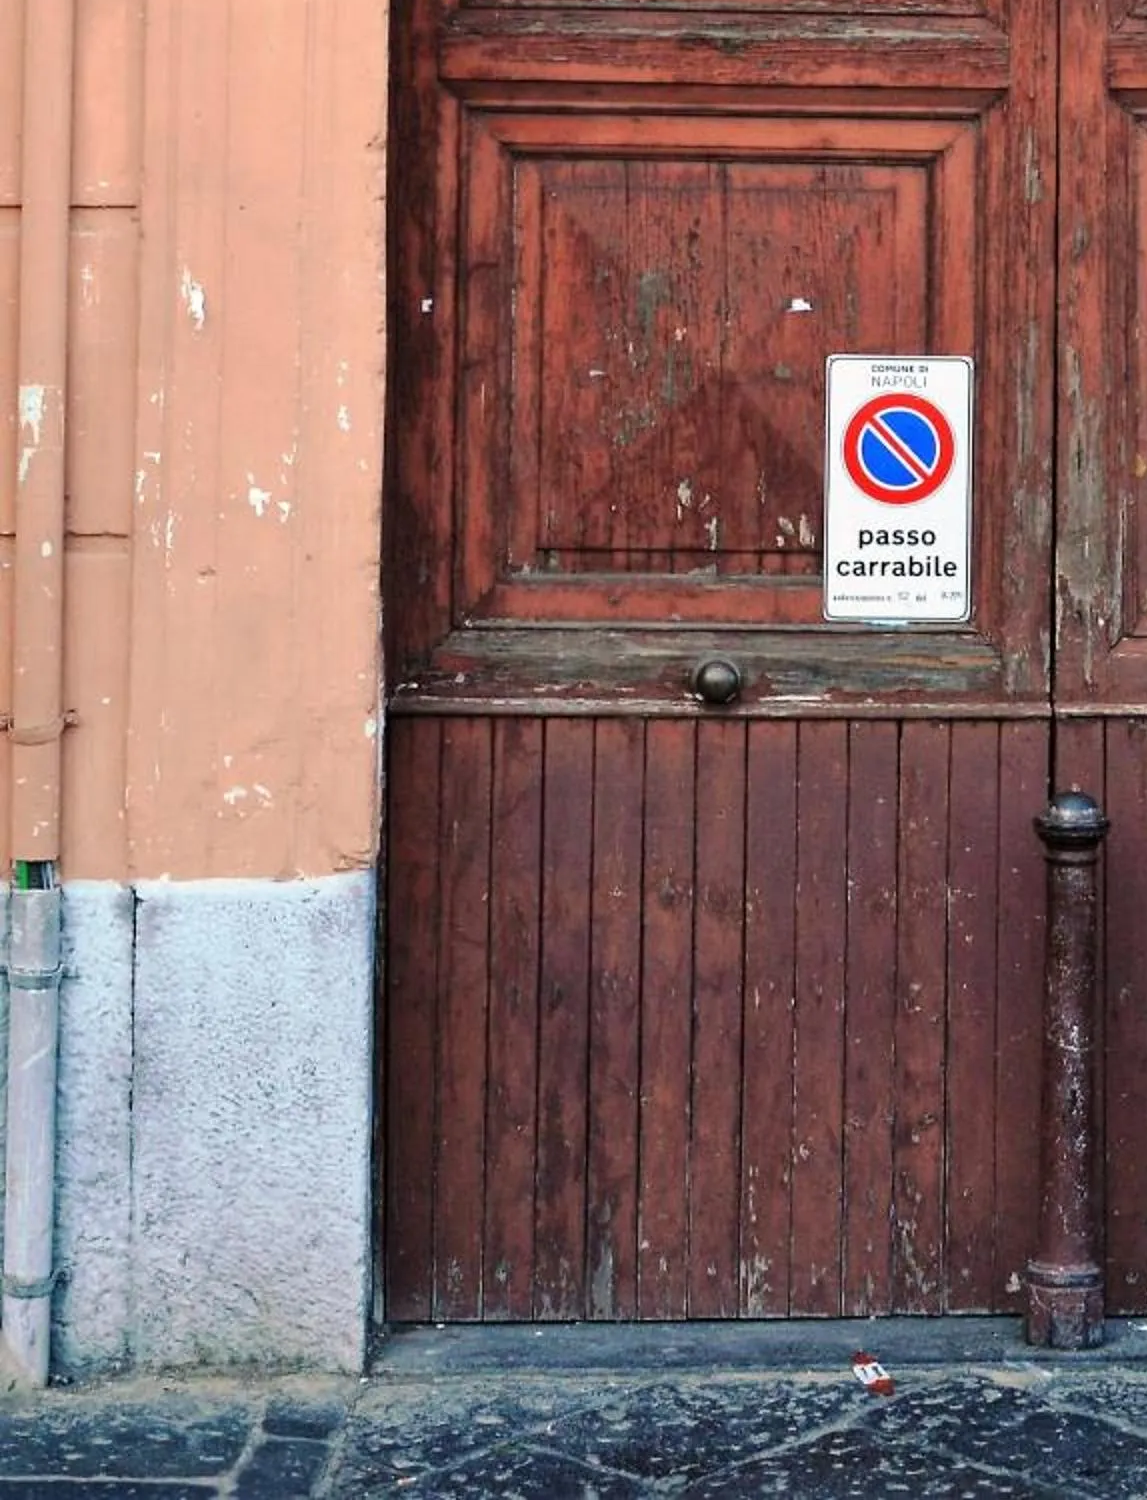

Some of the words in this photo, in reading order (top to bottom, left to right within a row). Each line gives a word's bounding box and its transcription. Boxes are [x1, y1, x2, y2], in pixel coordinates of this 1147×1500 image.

[871, 364, 914, 373] COMUNE
[918, 364, 929, 373] DI
[871, 375, 927, 388] NAPOLI
[858, 528, 936, 549] passo
[836, 555, 957, 577] carrabile
